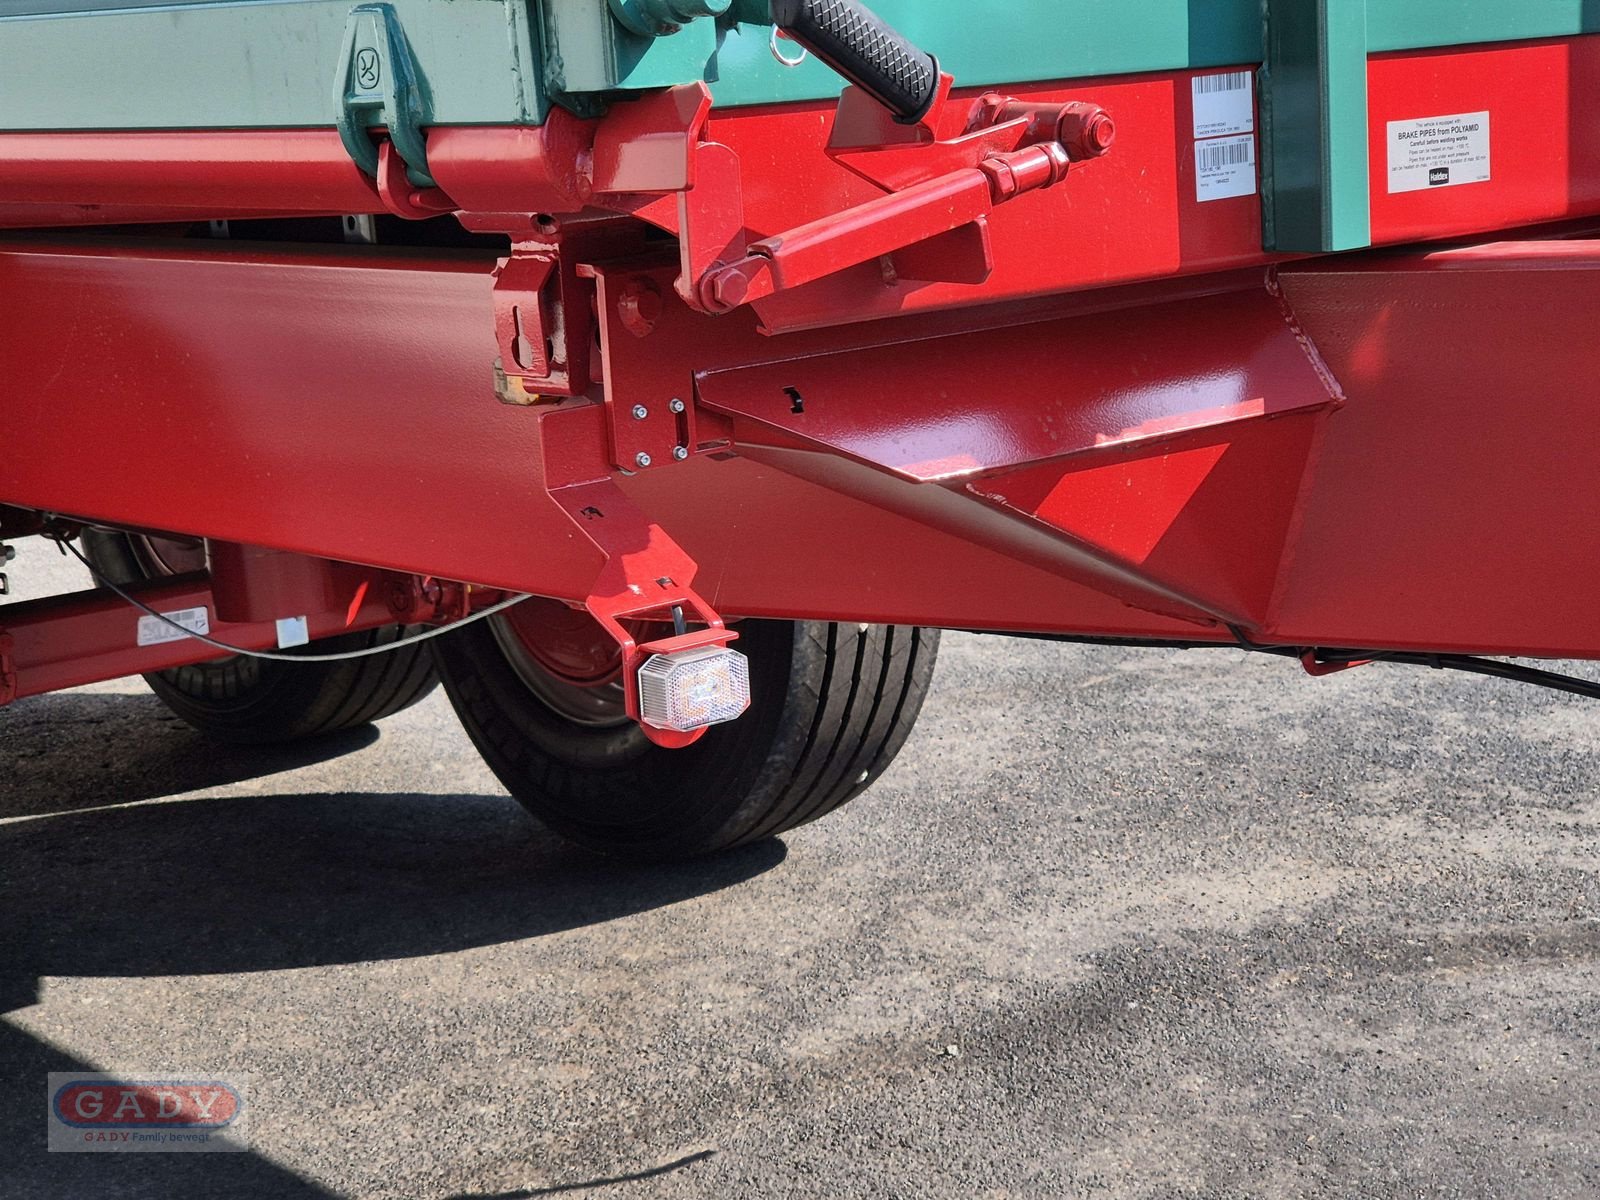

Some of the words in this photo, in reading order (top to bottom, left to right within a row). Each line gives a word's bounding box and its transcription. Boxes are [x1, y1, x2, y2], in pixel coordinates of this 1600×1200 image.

[1398, 131, 1418, 140] BRAKE
[1420, 128, 1436, 138] PIPES
[1437, 128, 1450, 136] from
[1451, 124, 1479, 134] POLYAMID
[1430, 172, 1448, 182] Haldex
